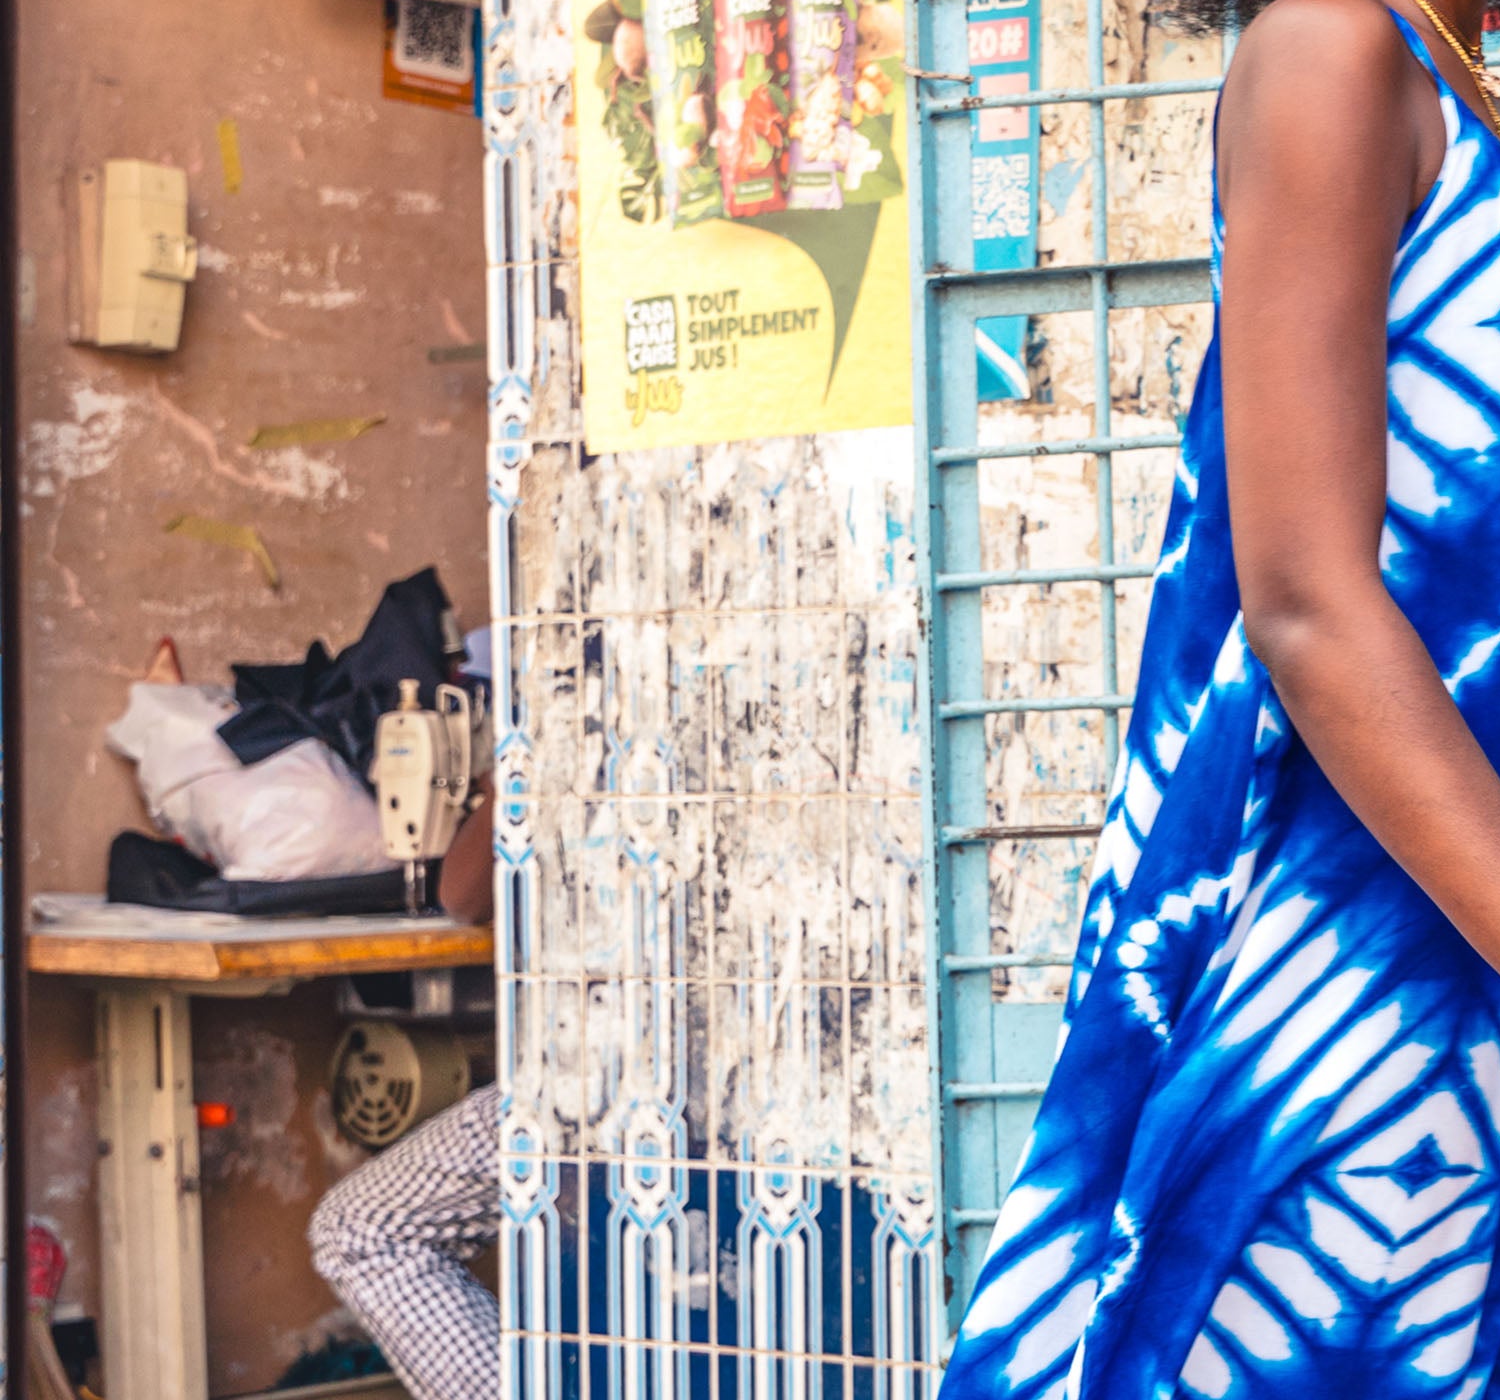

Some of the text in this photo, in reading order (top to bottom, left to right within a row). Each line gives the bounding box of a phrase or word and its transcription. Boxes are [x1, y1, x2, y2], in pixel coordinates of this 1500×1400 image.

[687, 289, 740, 316] TOUT
[688, 307, 820, 344] SIMPLEMENT
[689, 346, 726, 372] JUS
